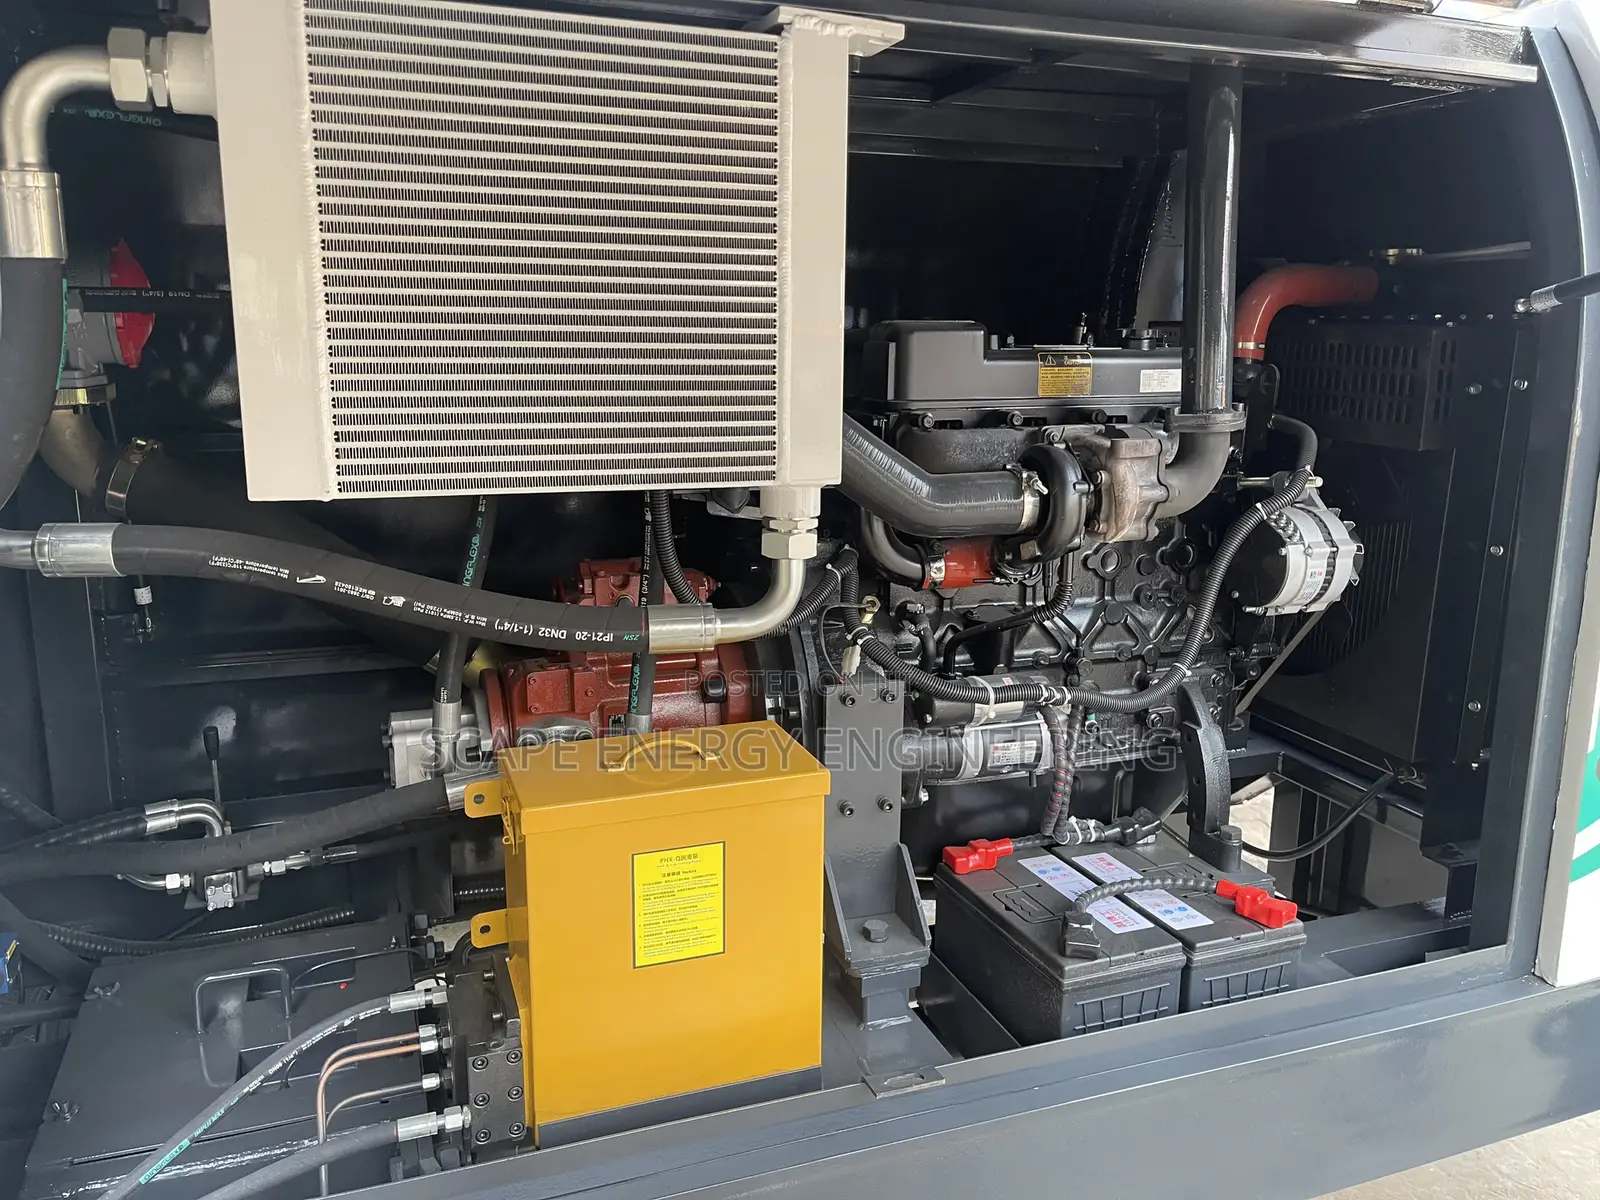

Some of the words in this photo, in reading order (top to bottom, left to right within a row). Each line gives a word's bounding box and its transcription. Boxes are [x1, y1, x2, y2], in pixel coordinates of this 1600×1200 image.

[243, 564, 276, 576] temperature
[245, 559, 278, 571] temperature
[462, 541, 479, 587] INGFLEX
[538, 626, 566, 639] DN32
[575, 630, 613, 642] IP21-20
[630, 671, 640, 714] INGFLEX
